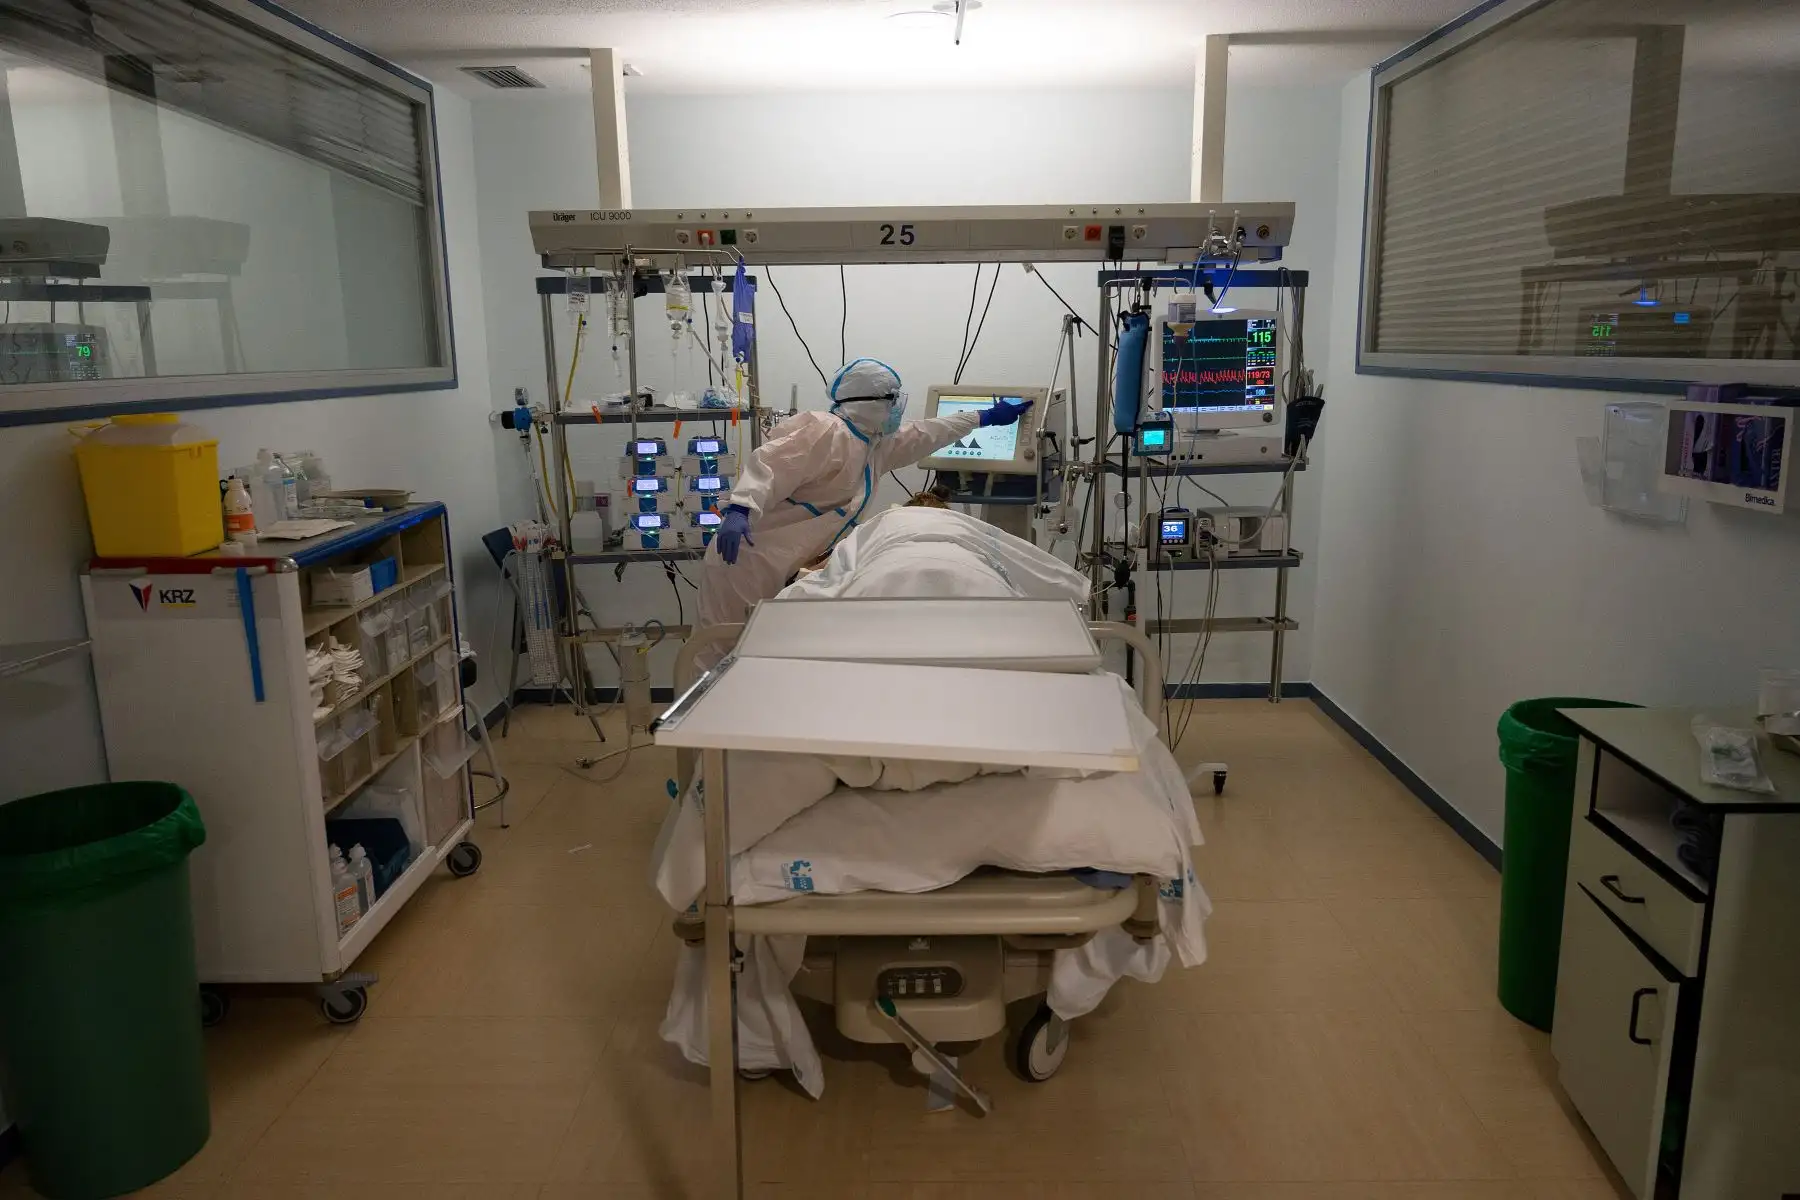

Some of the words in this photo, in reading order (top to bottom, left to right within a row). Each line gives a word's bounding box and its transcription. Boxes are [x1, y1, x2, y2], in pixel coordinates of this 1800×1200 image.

[552, 212, 576, 223] Dräger
[589, 211, 606, 221] ICU
[608, 211, 632, 221] 9000
[880, 224, 915, 246] 25
[1252, 331, 1272, 343] 115
[75, 345, 91, 357] 79
[1247, 370, 1271, 379] 119/73
[1163, 525, 1178, 533] 36
[159, 589, 197, 604] KRZ
